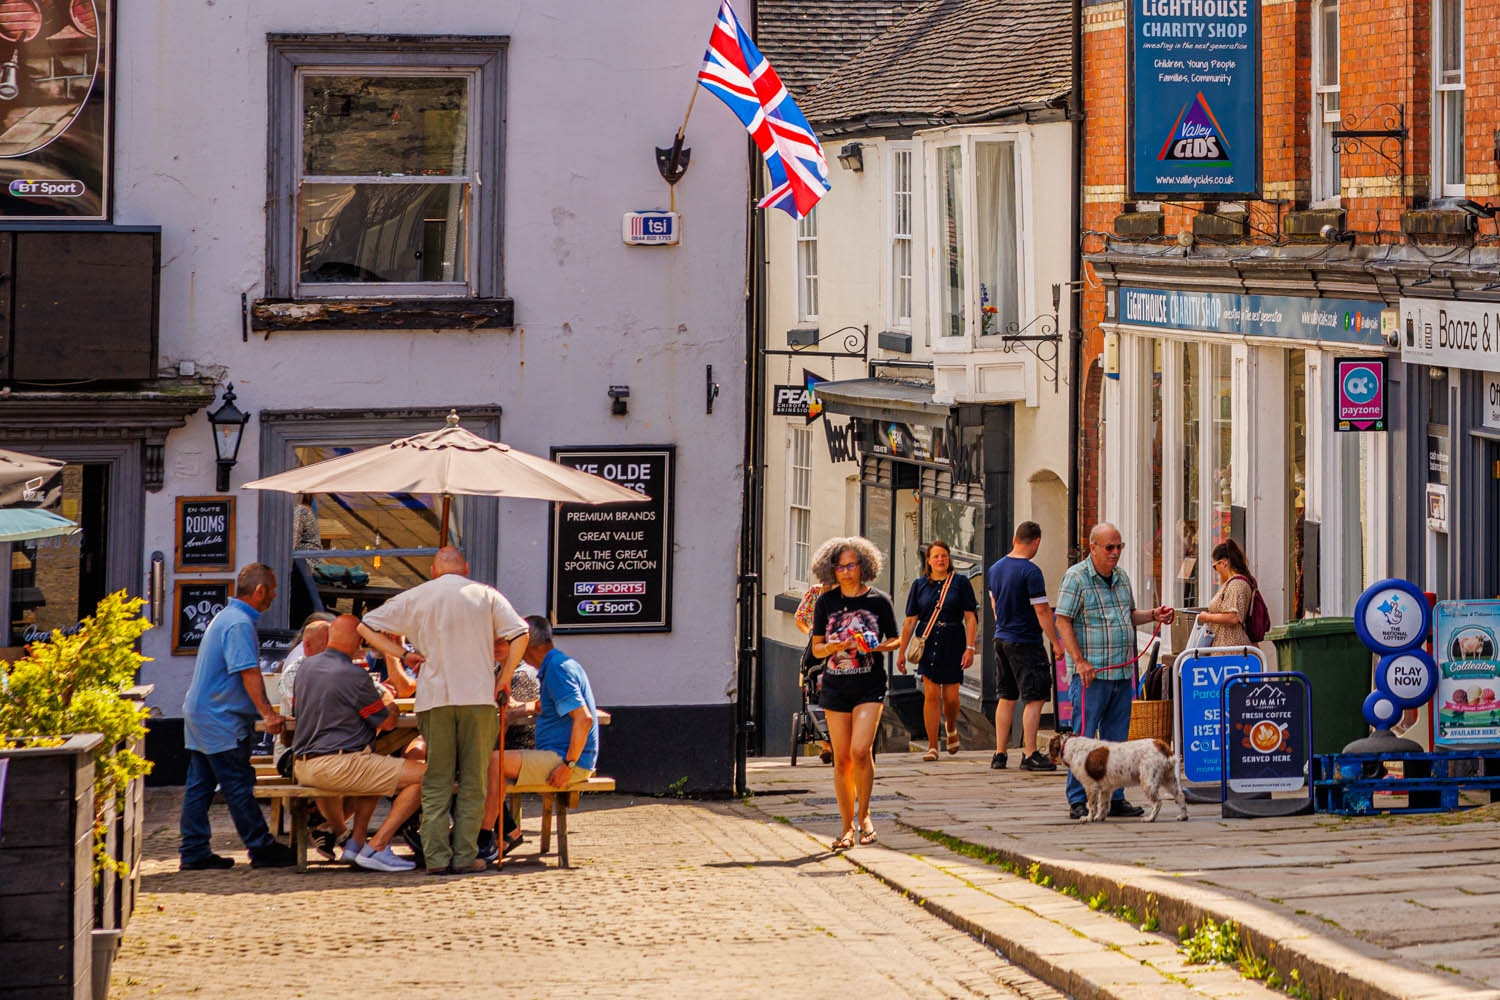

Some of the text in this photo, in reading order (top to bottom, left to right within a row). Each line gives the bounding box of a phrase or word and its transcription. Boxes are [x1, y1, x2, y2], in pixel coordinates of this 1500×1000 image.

[1143, 22, 1247, 38] CHARITY SHOP
[1143, 42, 1173, 51] investing
[1209, 43, 1247, 51] generation
[1154, 59, 1236, 72] Children, Young People
[1159, 73, 1231, 86] Families, Community
[1182, 121, 1212, 139] Valley
[1156, 174, 1234, 188] www.valleycids.co.uk
[19, 182, 77, 195] BT Sport
[648, 219, 667, 233] tsi
[1170, 295, 1200, 326] CHARITY
[1201, 296, 1221, 328] SHOP
[1439, 309, 1478, 351] Booze
[1482, 312, 1491, 352] &
[777, 389, 822, 404] PEA
[1342, 406, 1380, 416] payzone
[604, 464, 651, 480] OLDE
[567, 511, 656, 521] PREMIUM BRANDS
[185, 515, 225, 533] ROOMS
[578, 531, 645, 541] GREAT VALUE
[574, 550, 649, 560] ALL THE GREAT
[565, 560, 657, 571] SPORTING ACTION
[577, 583, 643, 594] sky SPORTS
[585, 602, 635, 613] BT Sport
[1394, 666, 1421, 676] PLAY
[1450, 661, 1496, 673] Coldeaton
[1394, 676, 1422, 687] NOW
[1245, 698, 1287, 707] SUMMIT
[1266, 711, 1292, 719] COFFEE
[1450, 729, 1481, 737] AVAILABLE
[1242, 755, 1270, 763] SERVED
